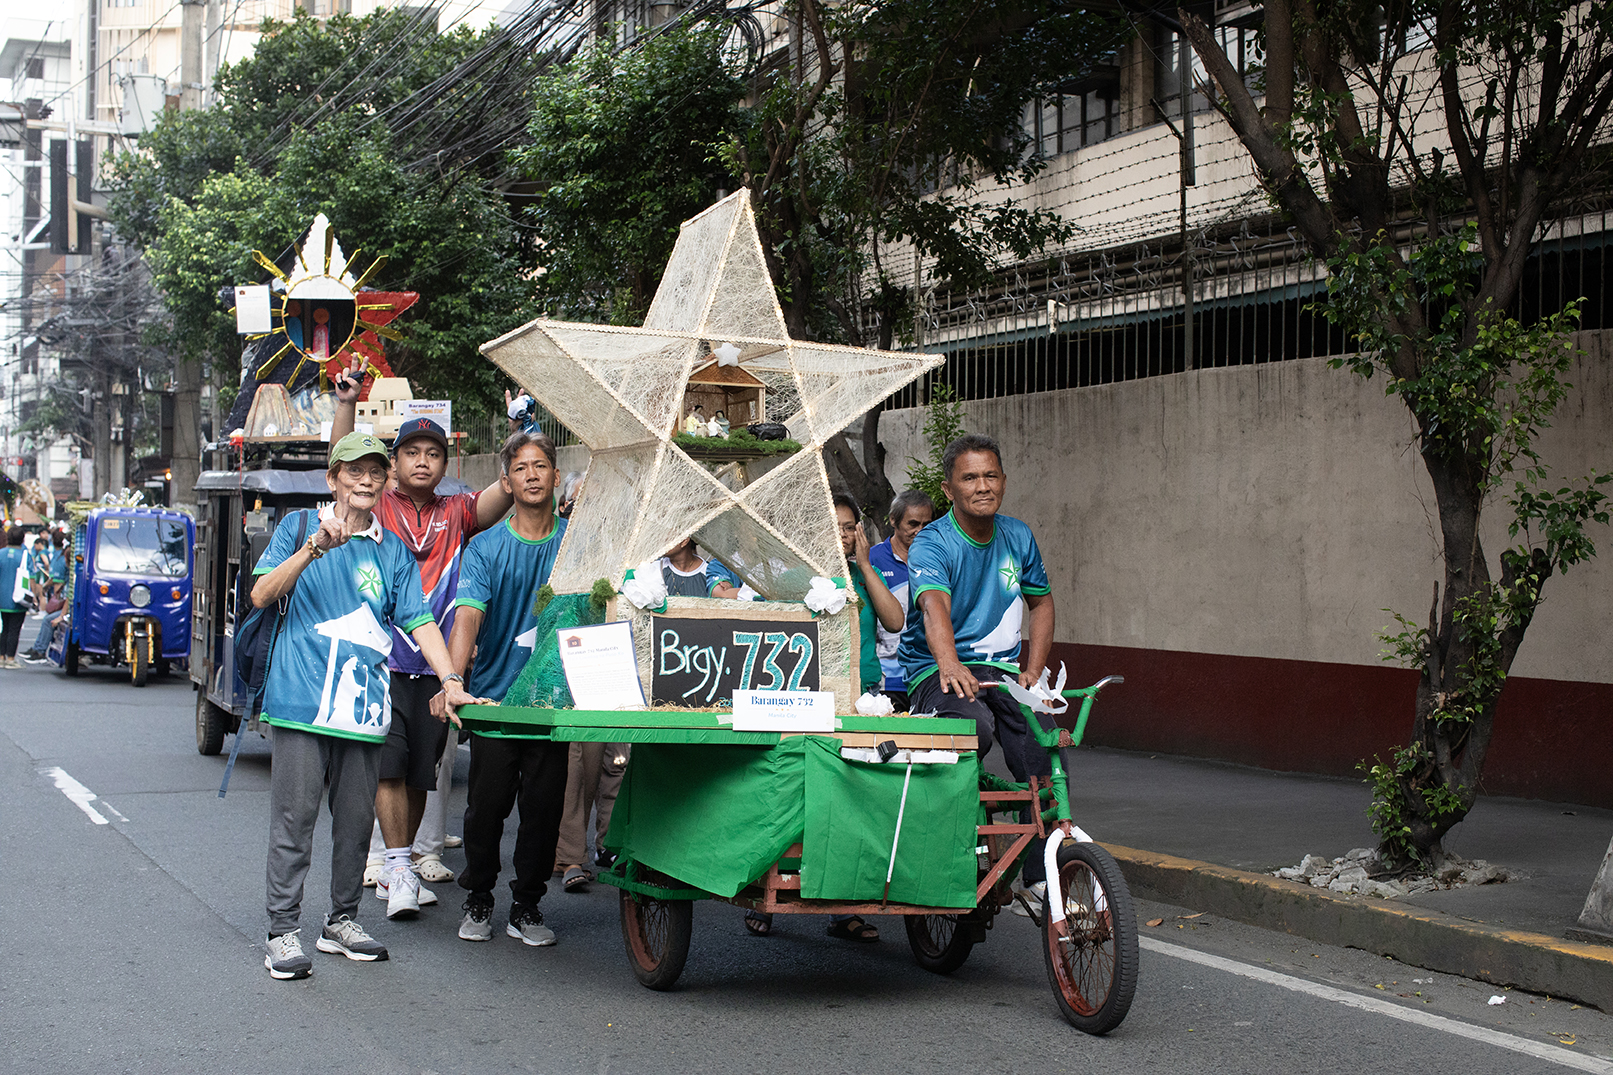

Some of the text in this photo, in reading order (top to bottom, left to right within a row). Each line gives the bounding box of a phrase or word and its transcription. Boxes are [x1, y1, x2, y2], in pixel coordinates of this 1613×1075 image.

[417, 418, 431, 429] NY
[659, 629, 814, 702] Brgy. 732
[751, 695, 814, 706] Barangay 732
